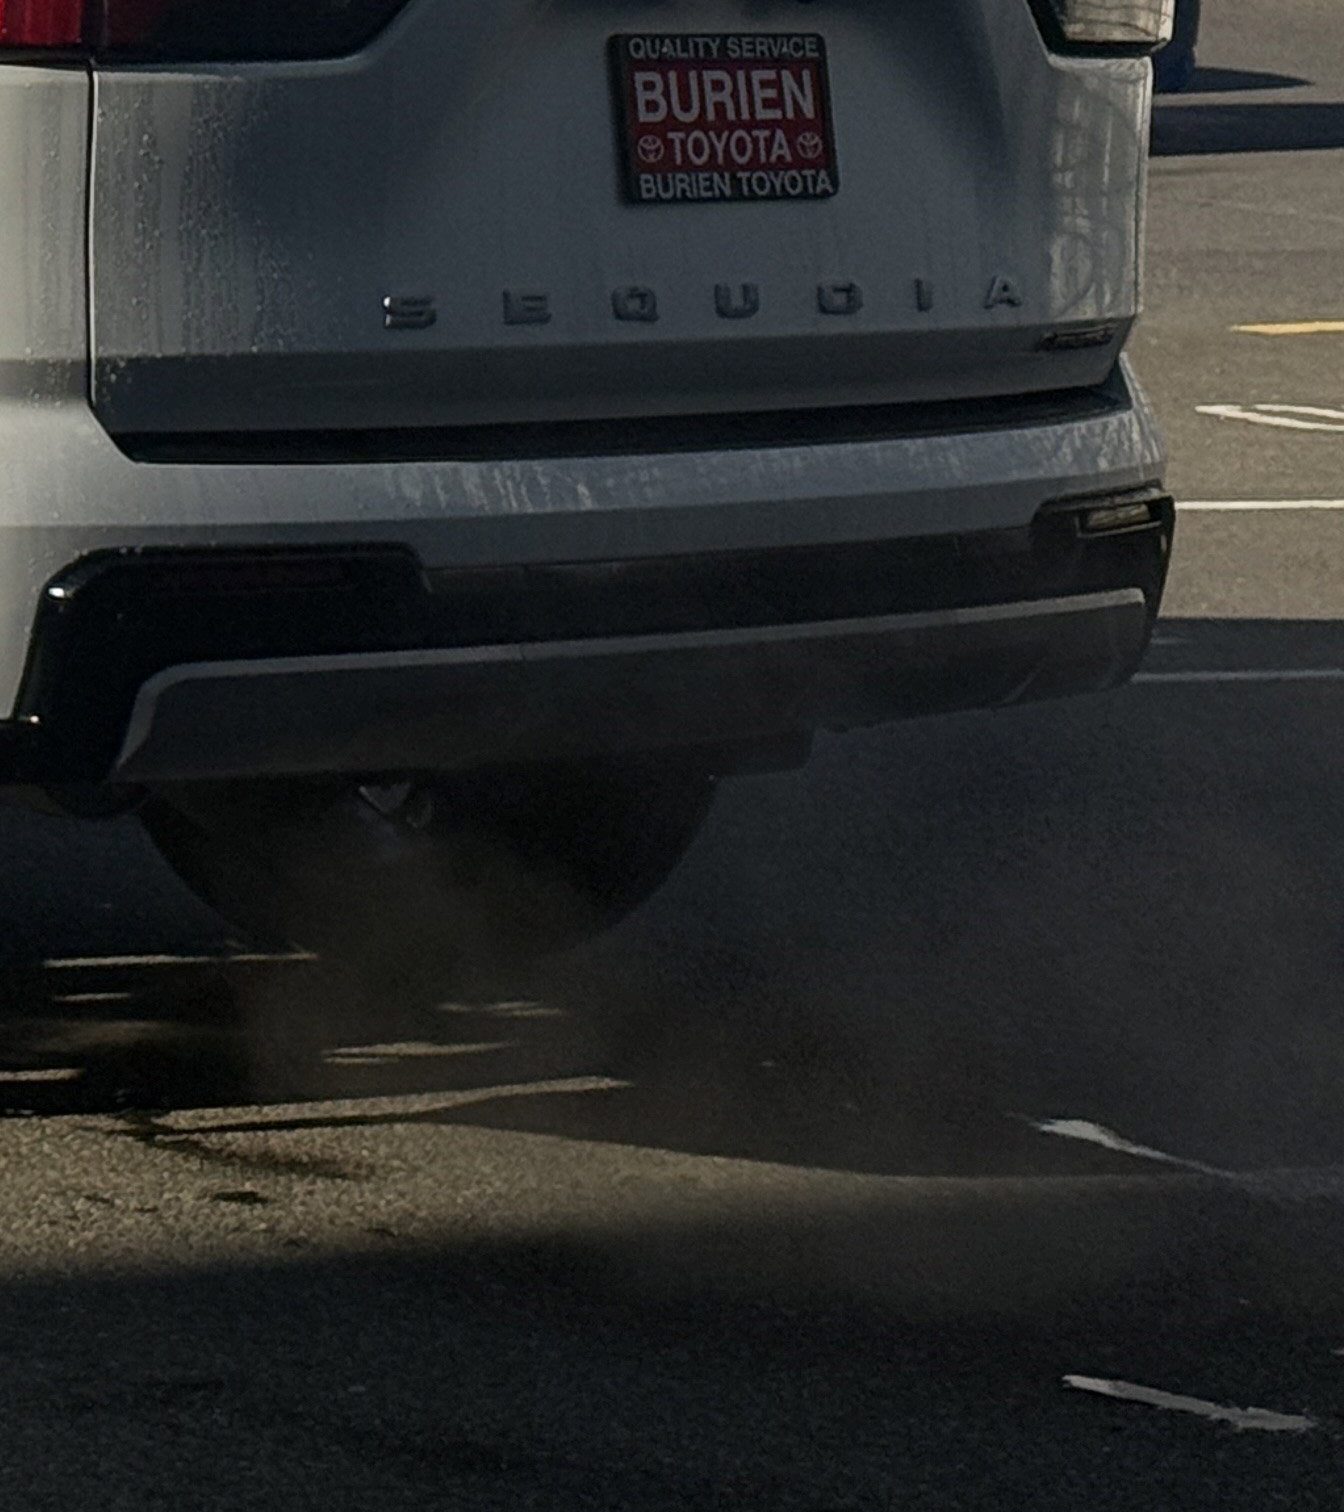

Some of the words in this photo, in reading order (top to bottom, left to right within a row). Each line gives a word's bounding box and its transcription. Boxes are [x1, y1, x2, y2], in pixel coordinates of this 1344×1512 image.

[628, 37, 721, 59] QUALITY
[727, 37, 820, 58] SERVICE
[634, 68, 815, 123] BURIEN
[667, 129, 793, 166] TOYOTA
[639, 172, 731, 199] BURIEN
[737, 169, 834, 197] TOYOTA
[383, 274, 1022, 329] SEQUOIA
